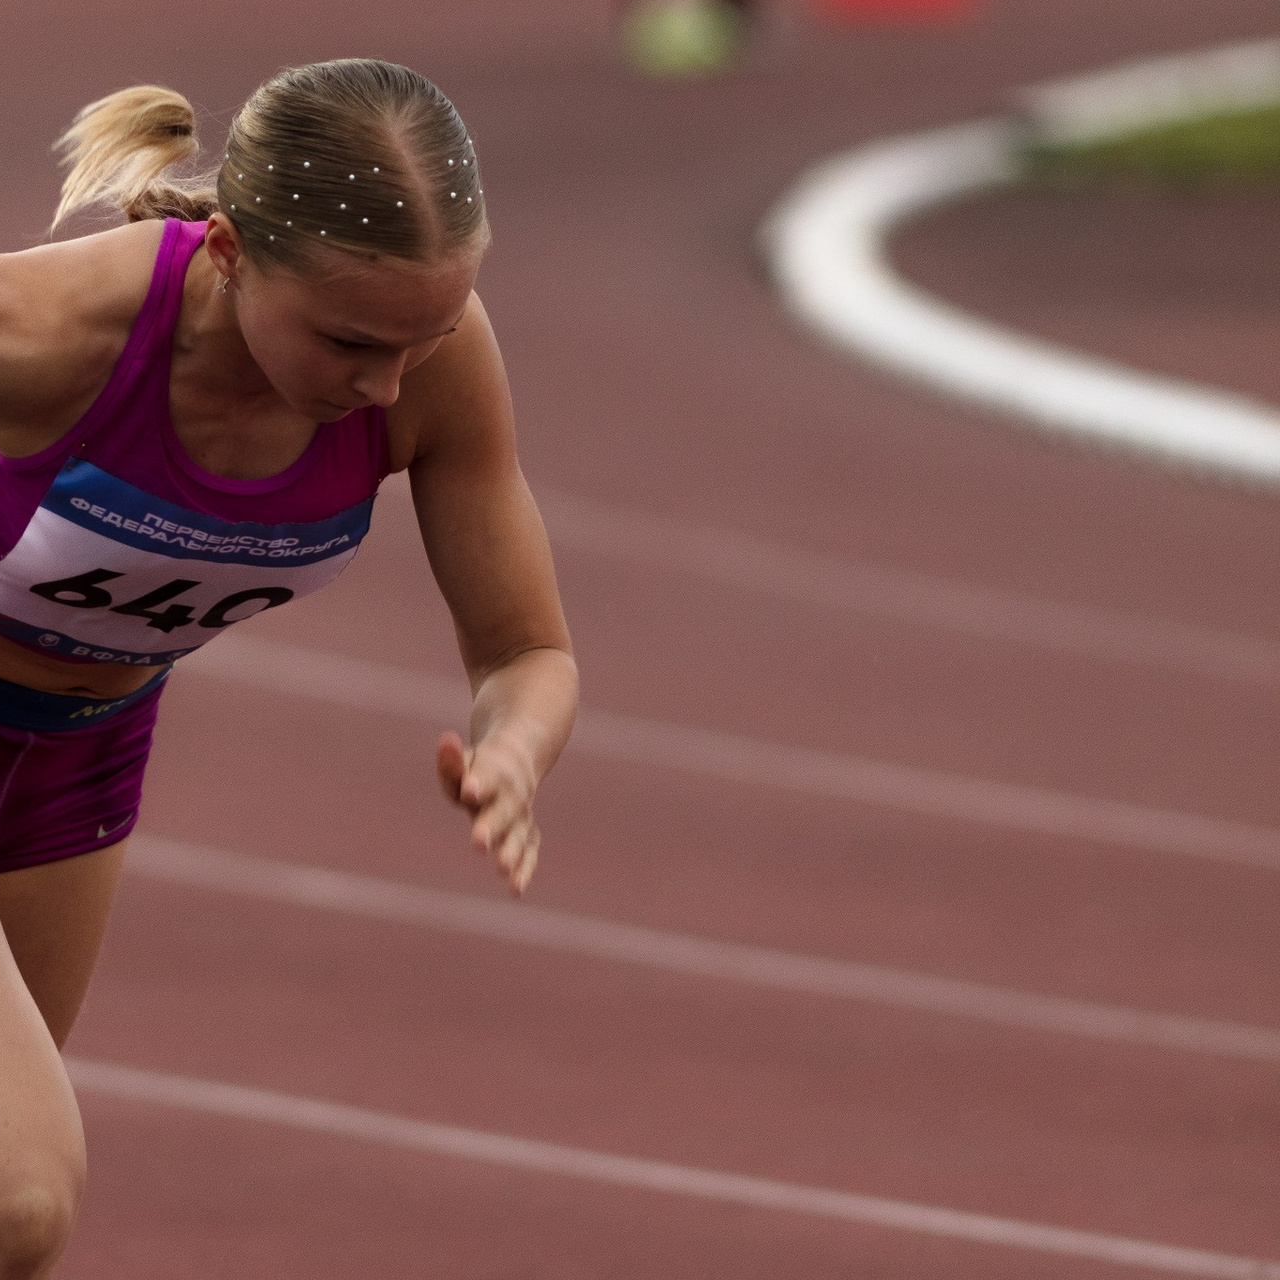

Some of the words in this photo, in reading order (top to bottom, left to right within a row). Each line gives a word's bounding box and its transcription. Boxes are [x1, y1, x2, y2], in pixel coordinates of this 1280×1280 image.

[69, 496, 267, 557] ФЕДЕРАЛЬНОГО
[268, 534, 351, 558] ОКРУГА
[143, 513, 300, 548] ПЕРВЕНСТВО
[29, 568, 294, 634] 640
[71, 646, 151, 664] ВФЛА
